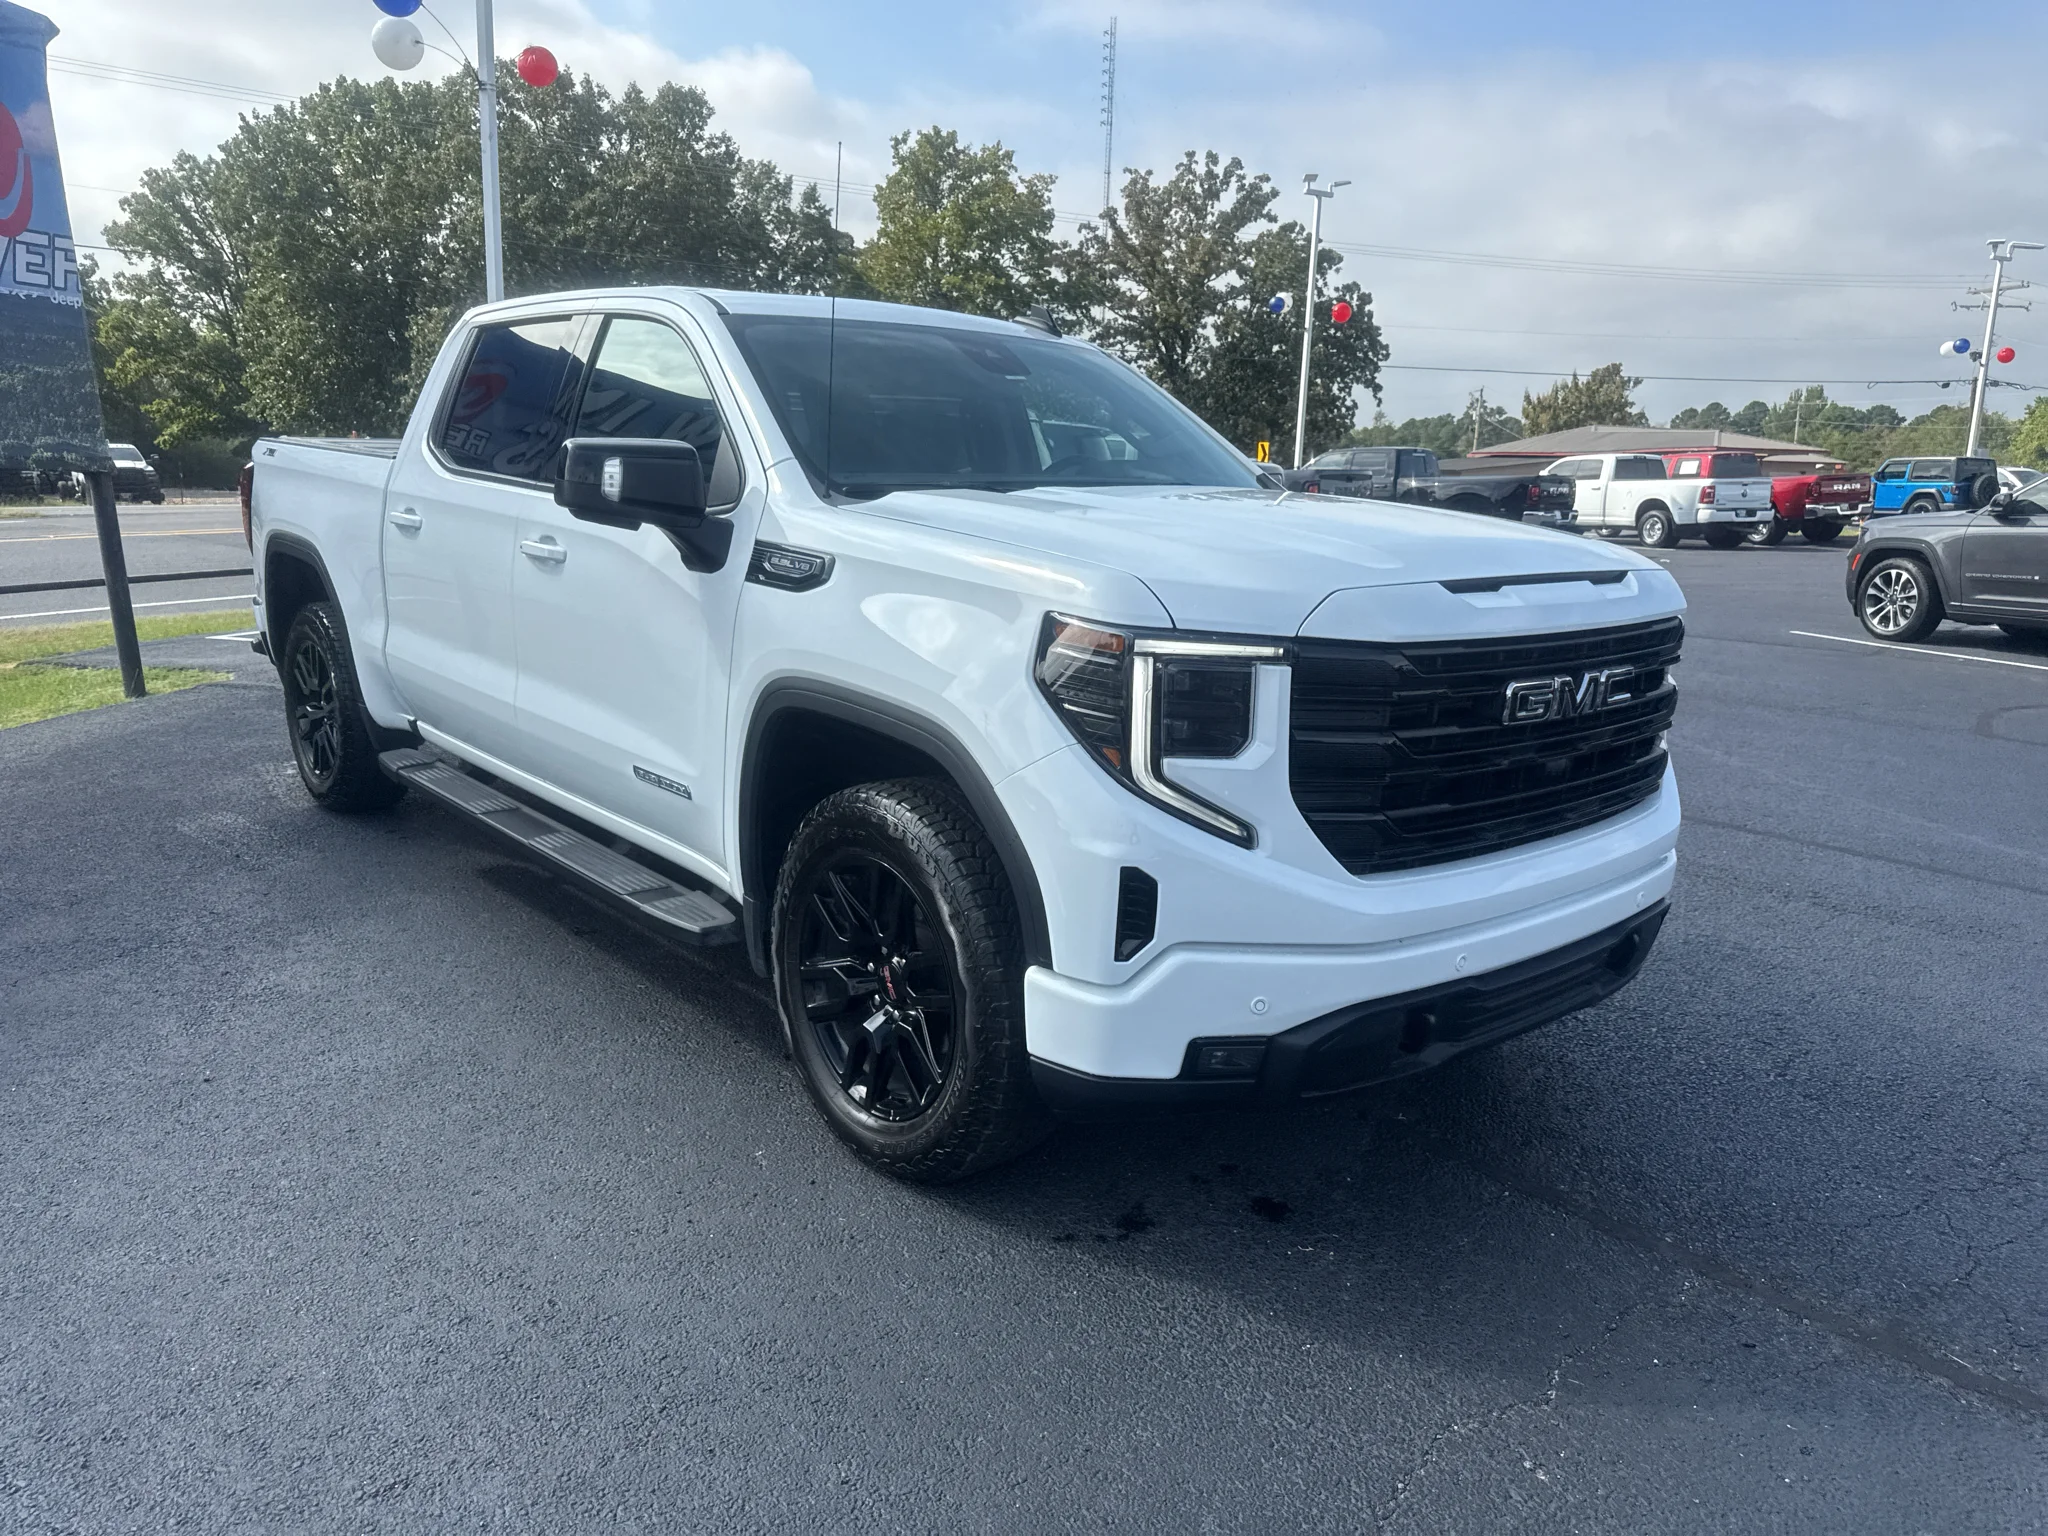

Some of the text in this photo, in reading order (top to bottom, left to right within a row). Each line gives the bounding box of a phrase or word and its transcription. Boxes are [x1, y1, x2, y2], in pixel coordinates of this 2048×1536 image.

[50, 291, 82, 309] Jeep
[1833, 483, 1861, 491] RAM
[1502, 667, 1634, 725] GMC
[880, 965, 897, 1000] GMC
